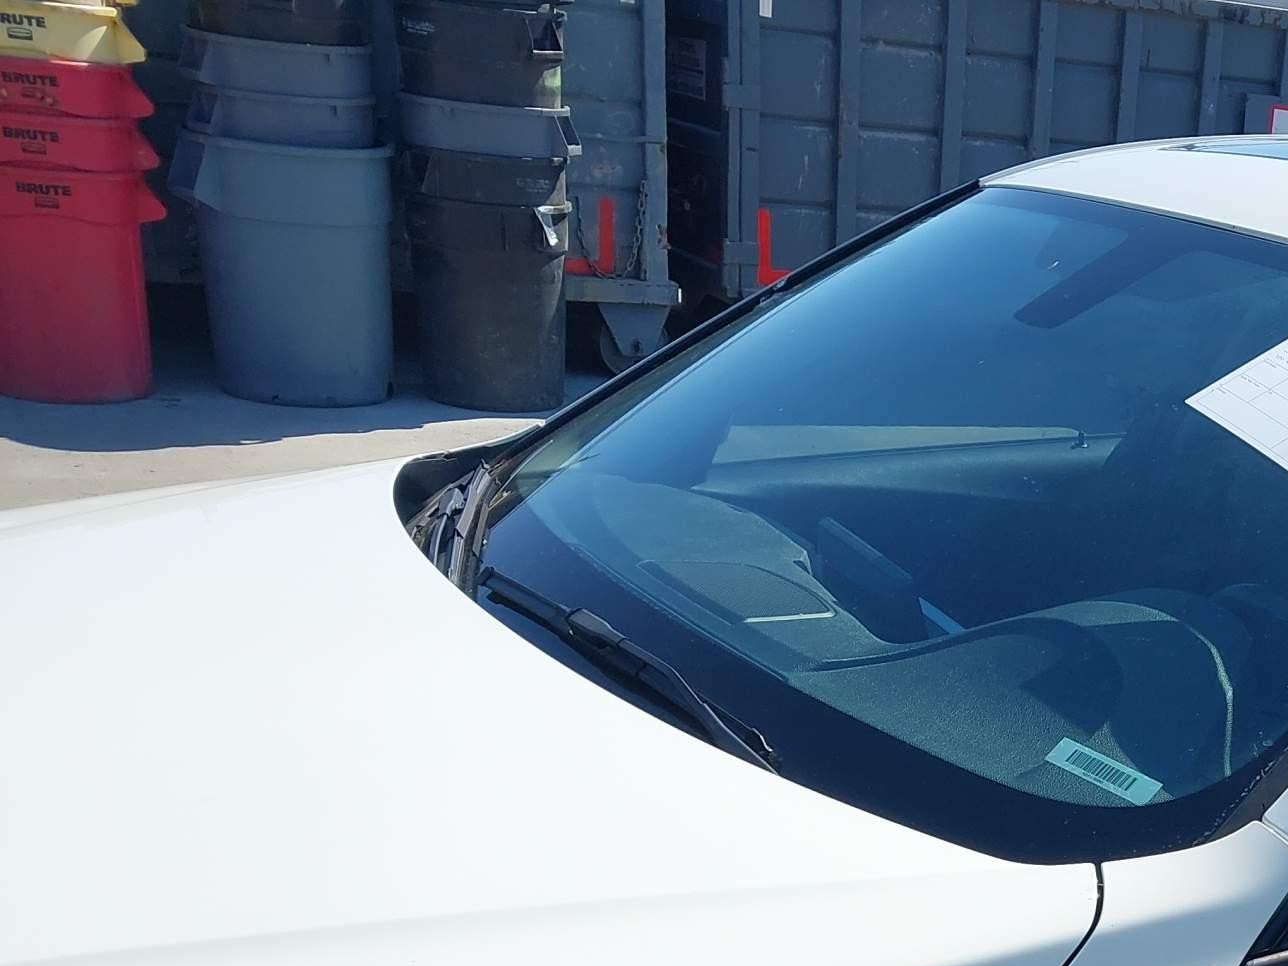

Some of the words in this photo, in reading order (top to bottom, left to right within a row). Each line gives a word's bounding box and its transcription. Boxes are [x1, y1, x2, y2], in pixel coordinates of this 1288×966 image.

[0, 12, 46, 28] RUTE
[2, 71, 58, 87] BRUTE
[3, 126, 59, 143] BRUTE
[16, 182, 72, 196] BRUTE
